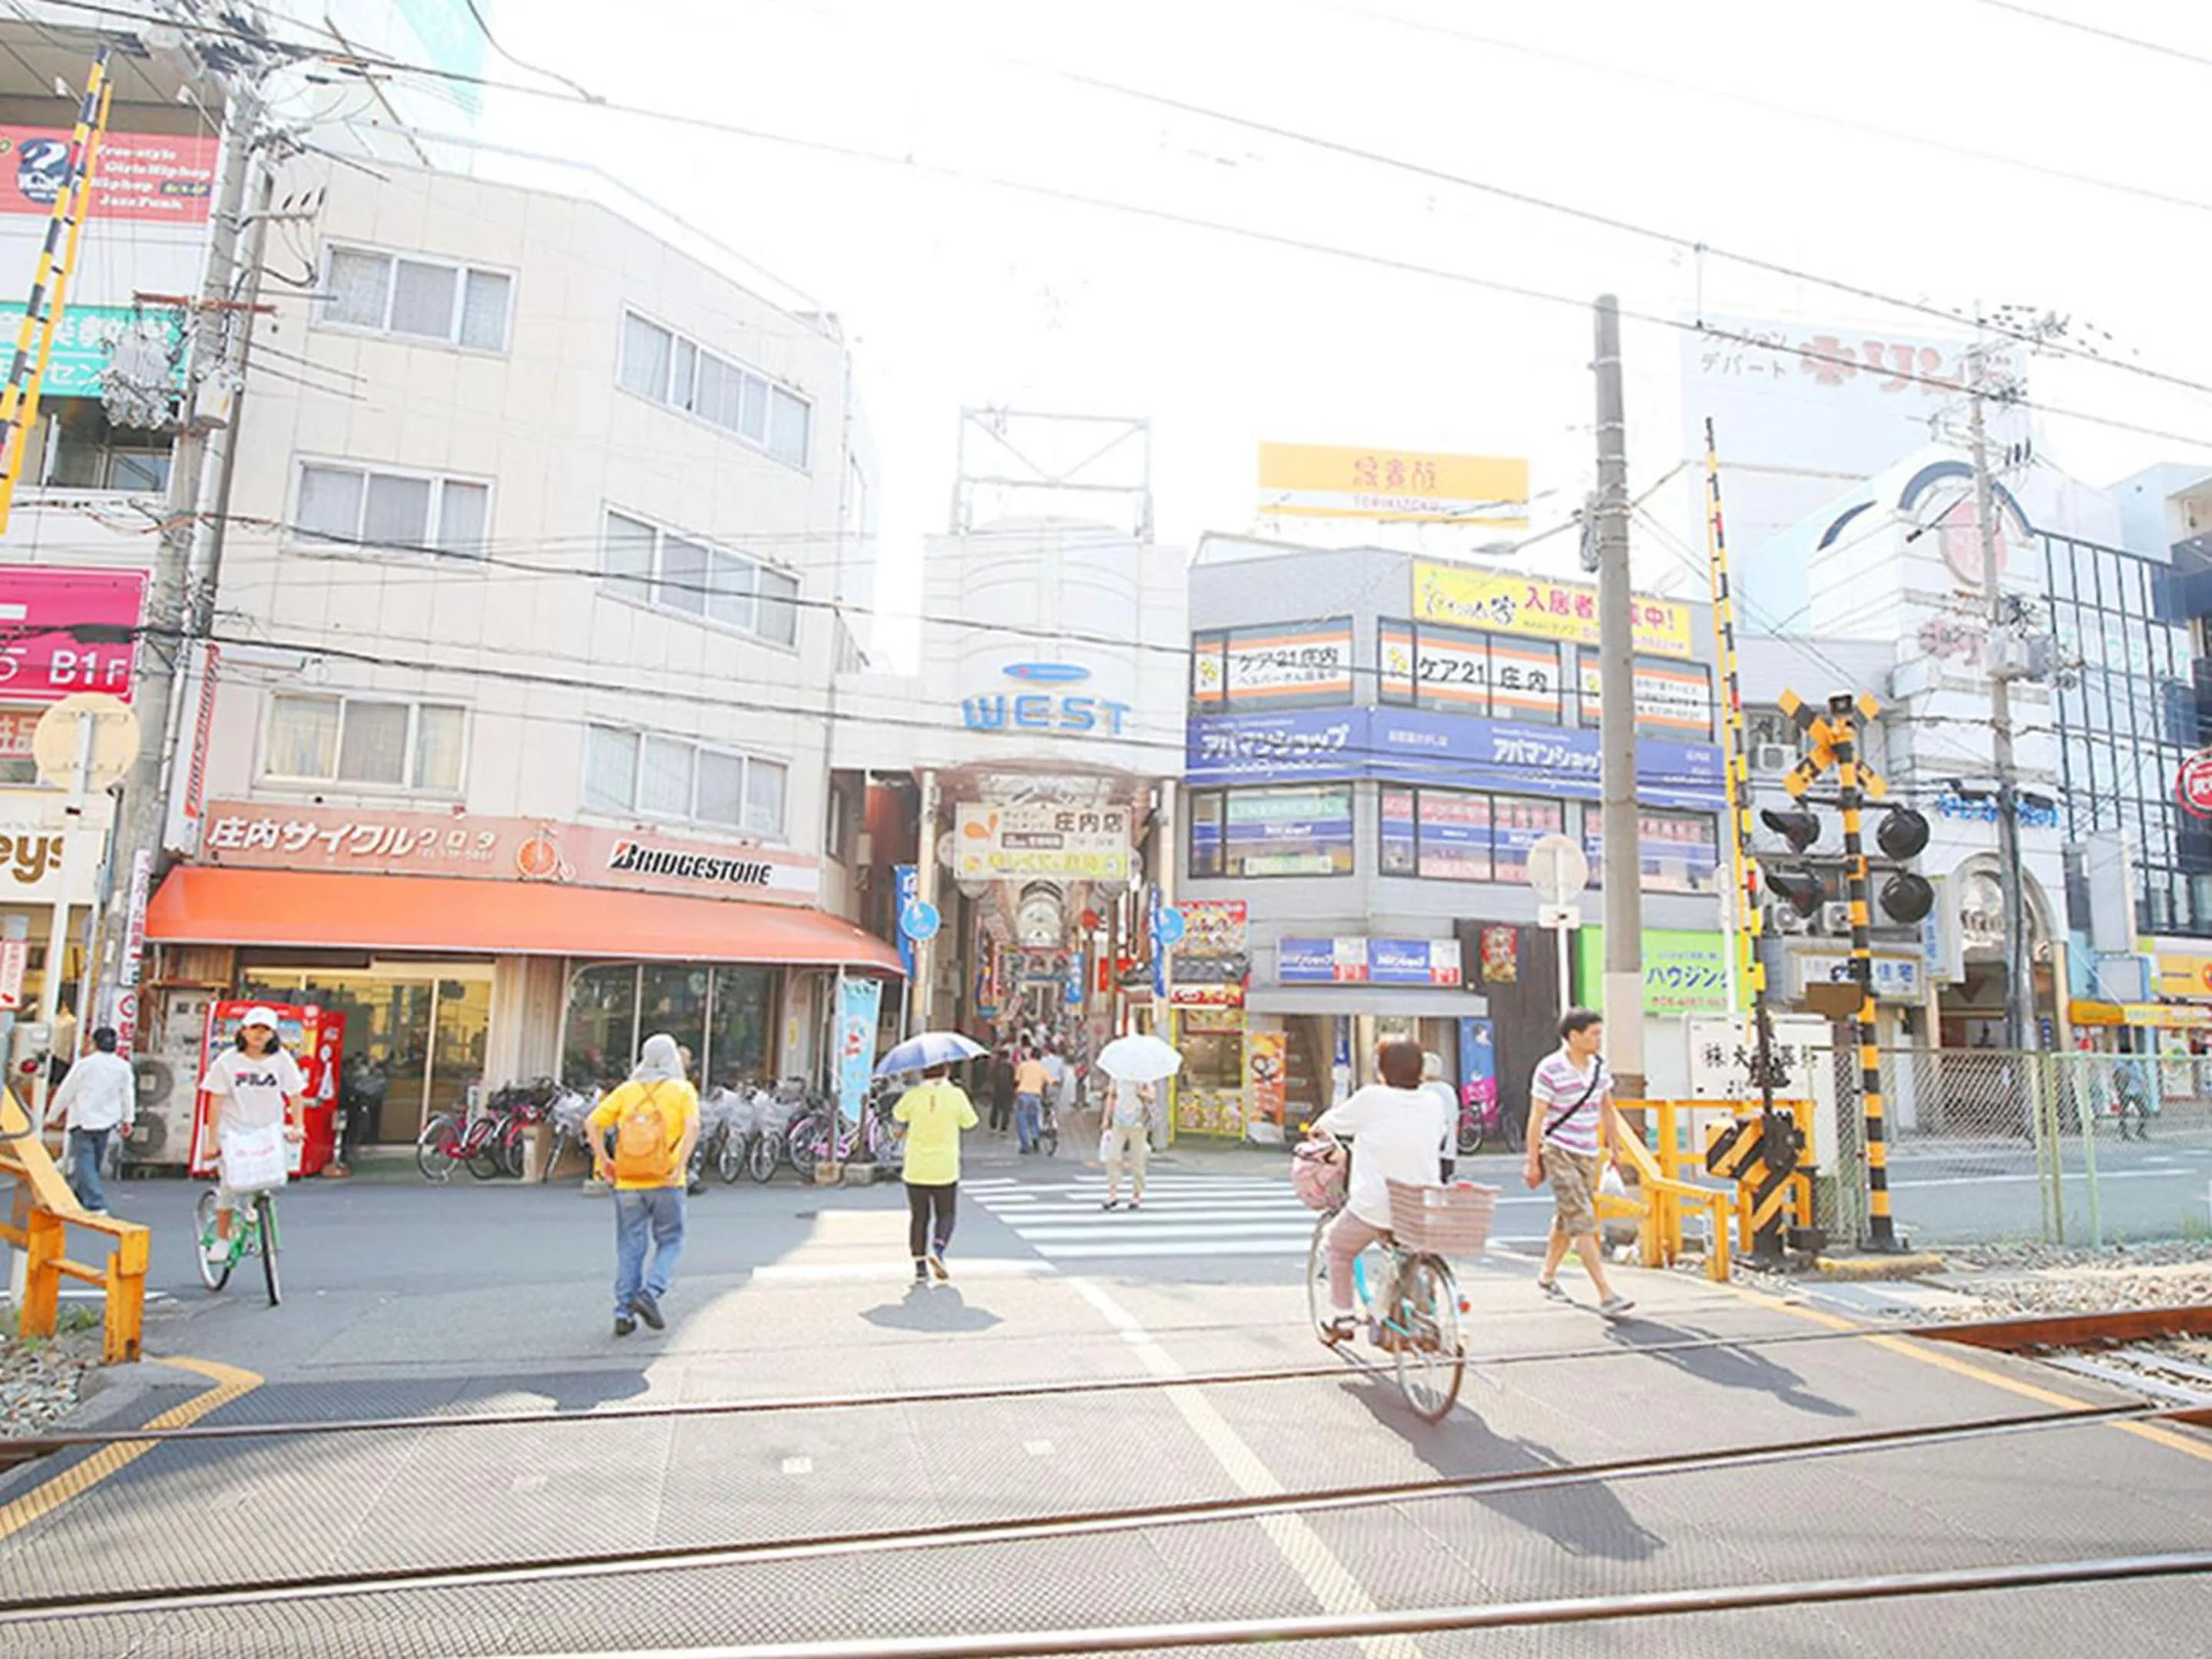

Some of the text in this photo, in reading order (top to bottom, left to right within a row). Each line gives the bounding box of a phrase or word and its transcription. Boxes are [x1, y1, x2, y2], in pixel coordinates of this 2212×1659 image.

[961, 694, 1133, 734] WEST
[207, 816, 417, 857] 庄内サイクル
[1055, 811, 1124, 834] 庄内店
[611, 842, 772, 886] BRIDGESTONE
[234, 1071, 278, 1088] FILA
